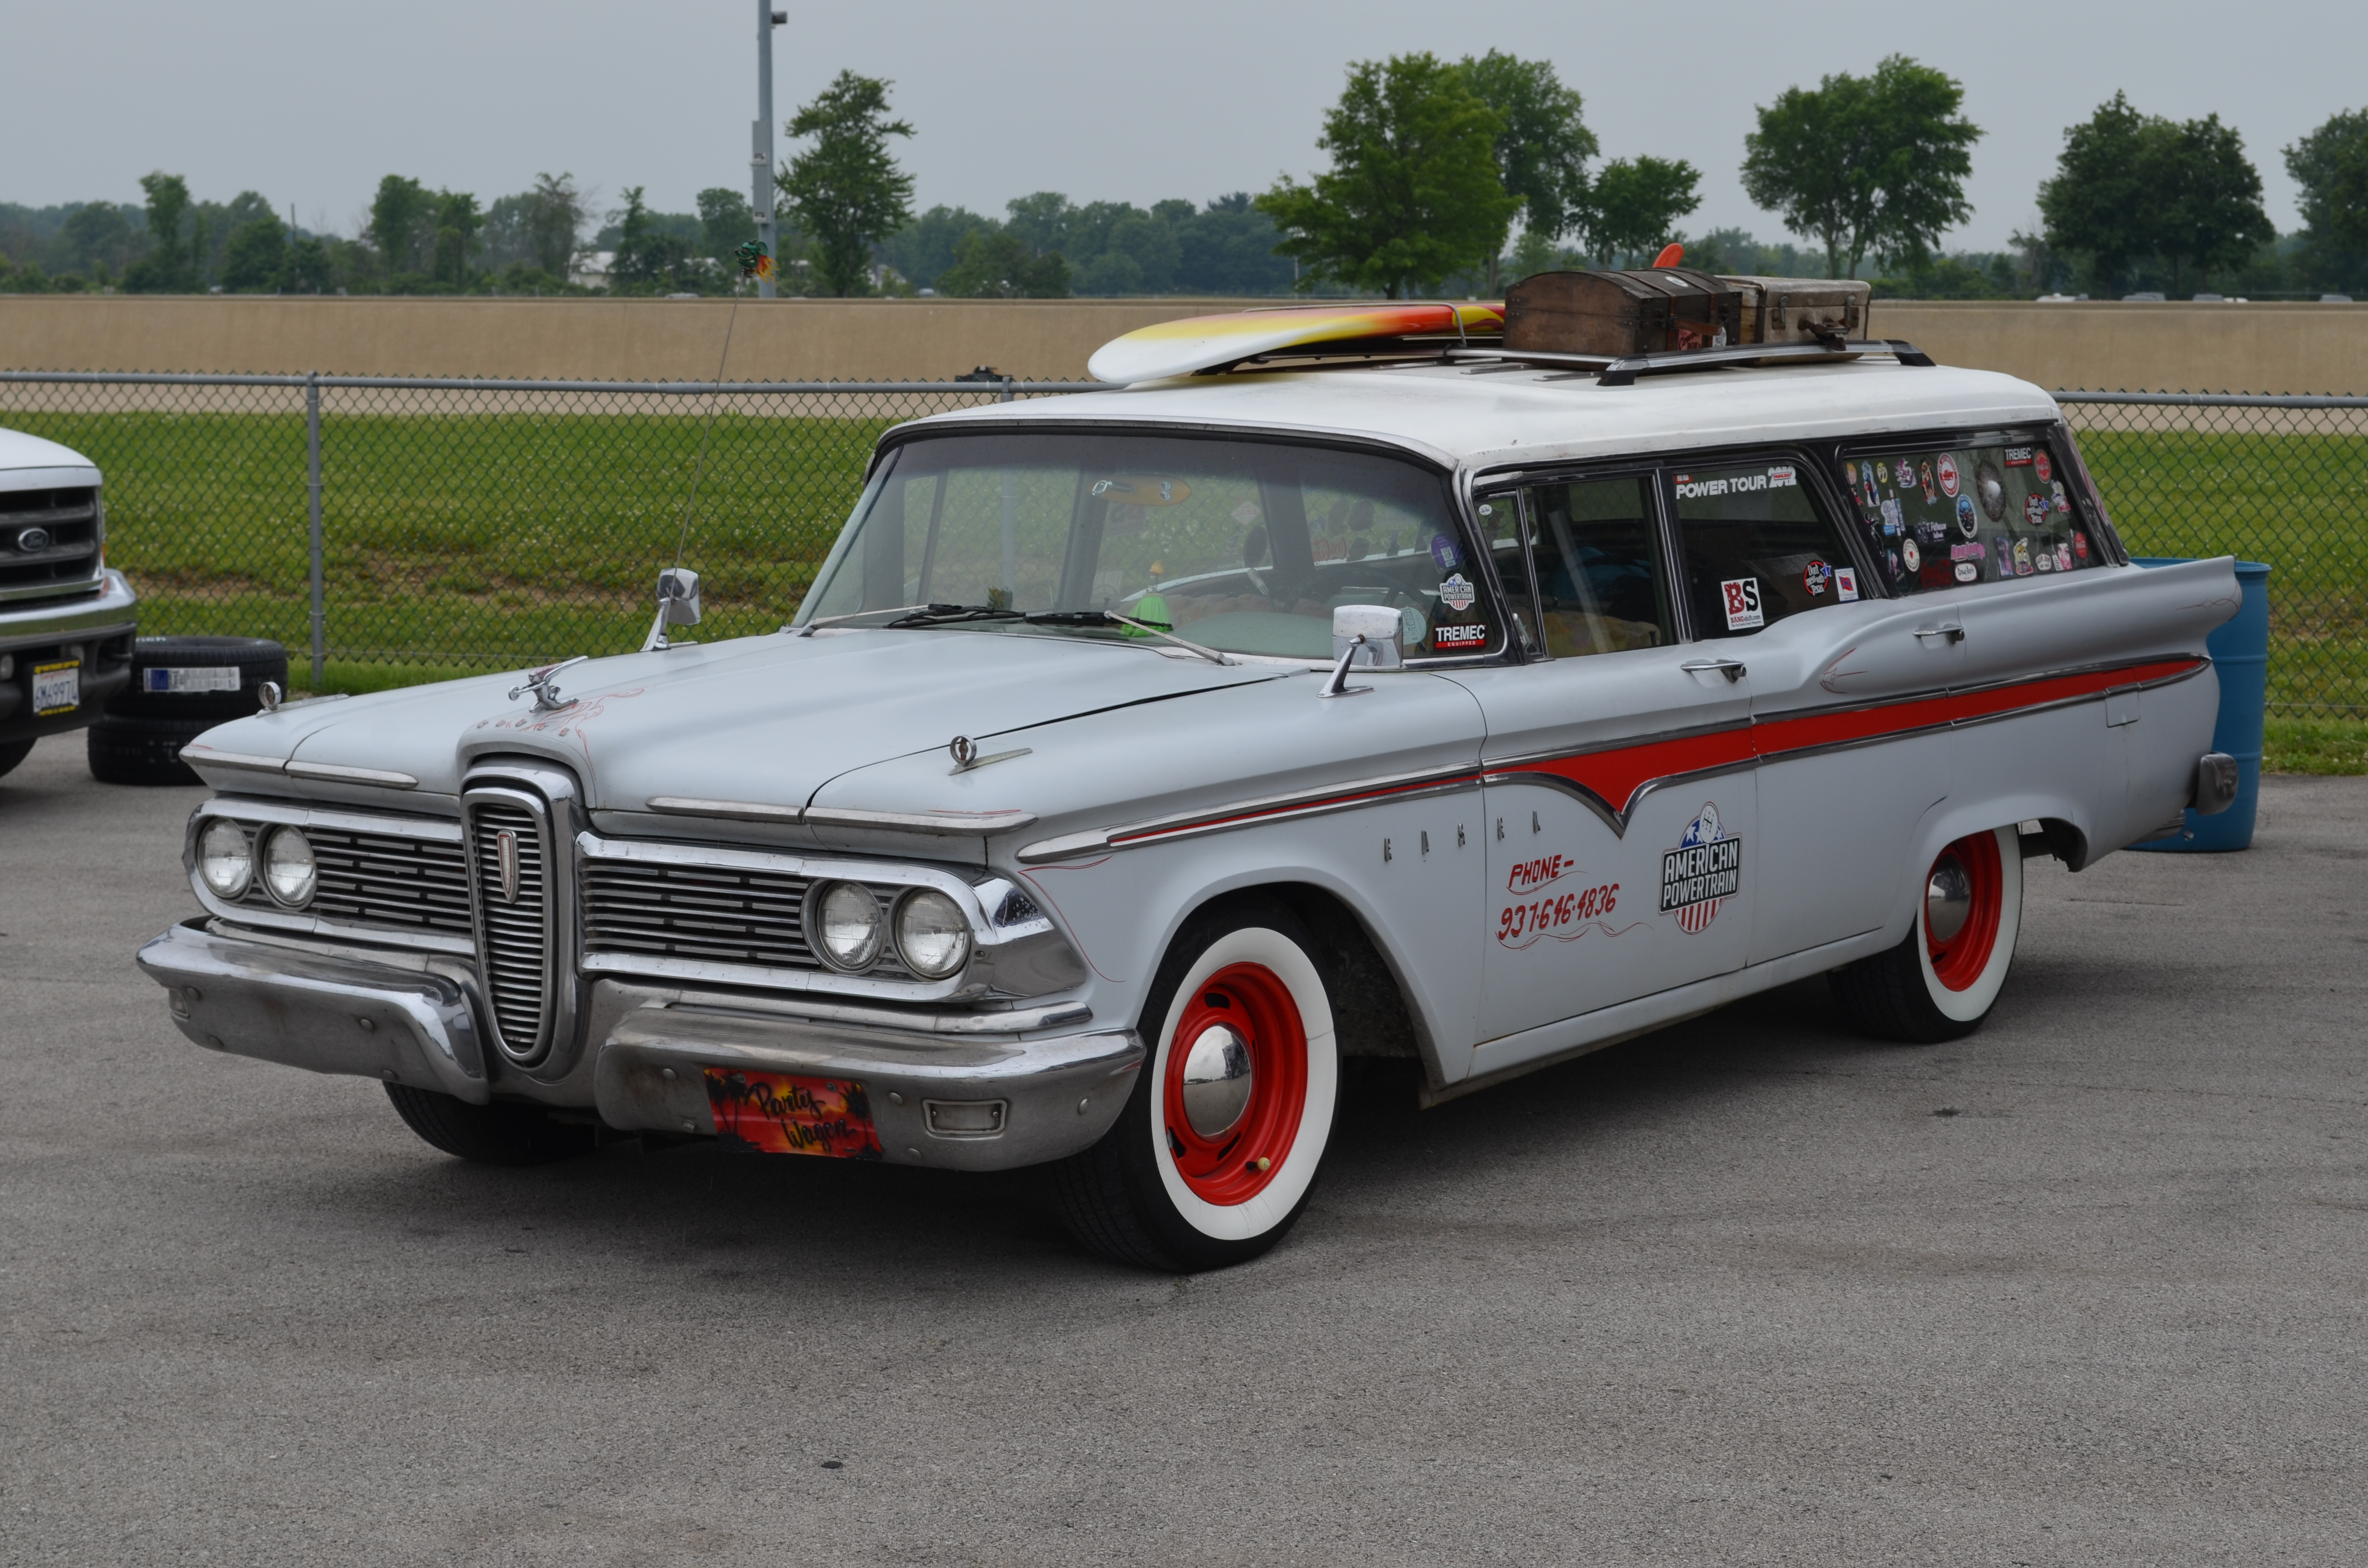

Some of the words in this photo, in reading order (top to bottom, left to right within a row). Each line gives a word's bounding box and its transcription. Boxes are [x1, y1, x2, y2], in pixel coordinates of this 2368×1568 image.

[2004, 447, 2032, 460] TREMEC
[1676, 479, 1728, 499] POWER
[1729, 475, 1767, 493] TOUR
[1442, 586, 1472, 594] AMERICAN
[1725, 579, 1759, 615] BS
[1435, 625, 1486, 642] TREMEC
[1664, 840, 1739, 883] AMERICAN
[1662, 869, 1737, 909] POWERTRAIN
[744, 1081, 826, 1120] Party
[780, 1117, 857, 1153] Wagon
